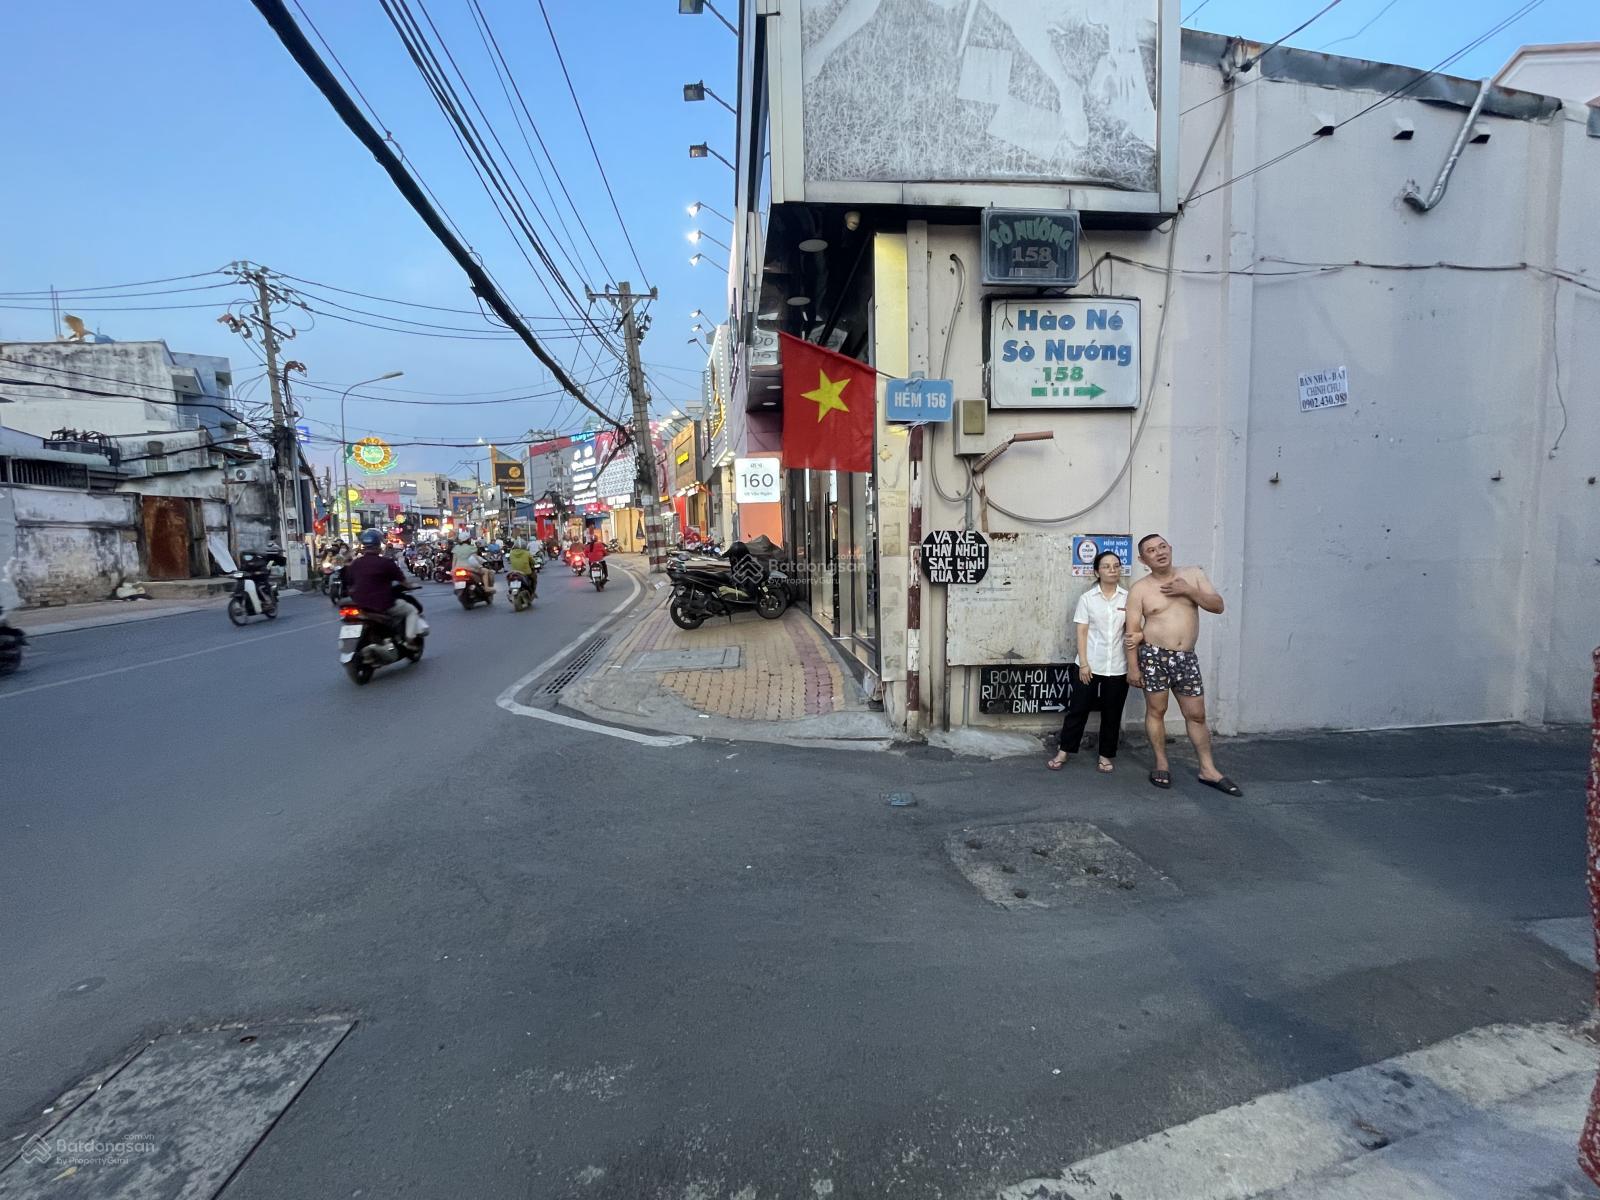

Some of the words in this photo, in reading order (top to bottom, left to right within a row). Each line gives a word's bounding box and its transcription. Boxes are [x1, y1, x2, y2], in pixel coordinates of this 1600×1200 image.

[1012, 246, 1053, 262] 158
[1018, 310, 1076, 331] Hào
[1086, 309, 1124, 330] Né
[1002, 340, 1036, 362] Sò
[1045, 340, 1132, 366] Nướng
[1043, 366, 1084, 382] 158
[740, 473, 774, 488] 160
[955, 530, 976, 544] XE
[922, 543, 953, 557] THAY
[957, 569, 977, 583] XE
[1008, 684, 1026, 699] XE
[1031, 683, 1066, 699] THAY
